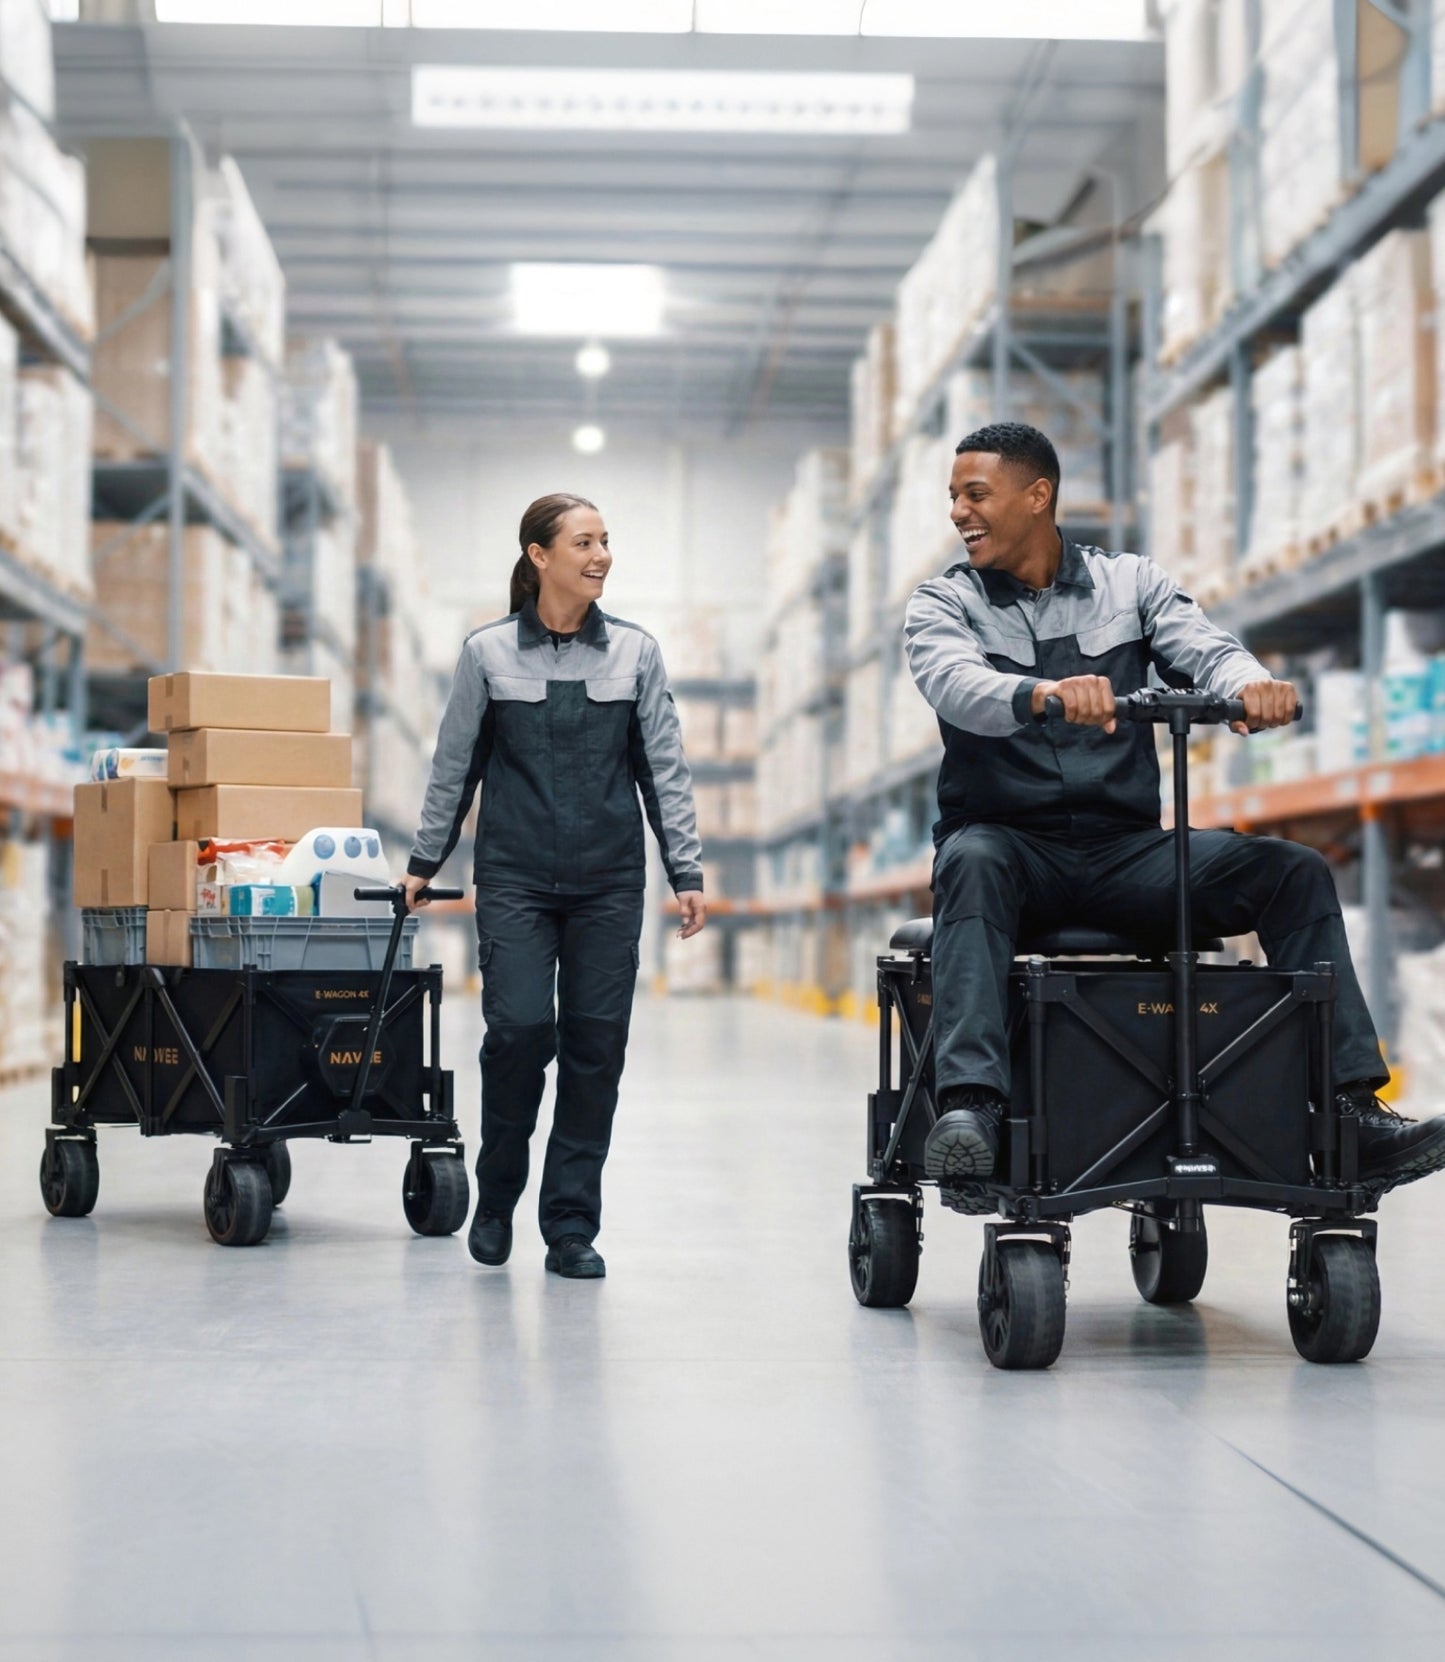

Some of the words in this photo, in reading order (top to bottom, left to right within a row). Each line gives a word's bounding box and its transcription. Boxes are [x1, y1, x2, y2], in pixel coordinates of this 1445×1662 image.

[1137, 1002, 1175, 1015] E-WA
[1199, 1002, 1218, 1014] 4X
[330, 1050, 382, 1065] NAVE
